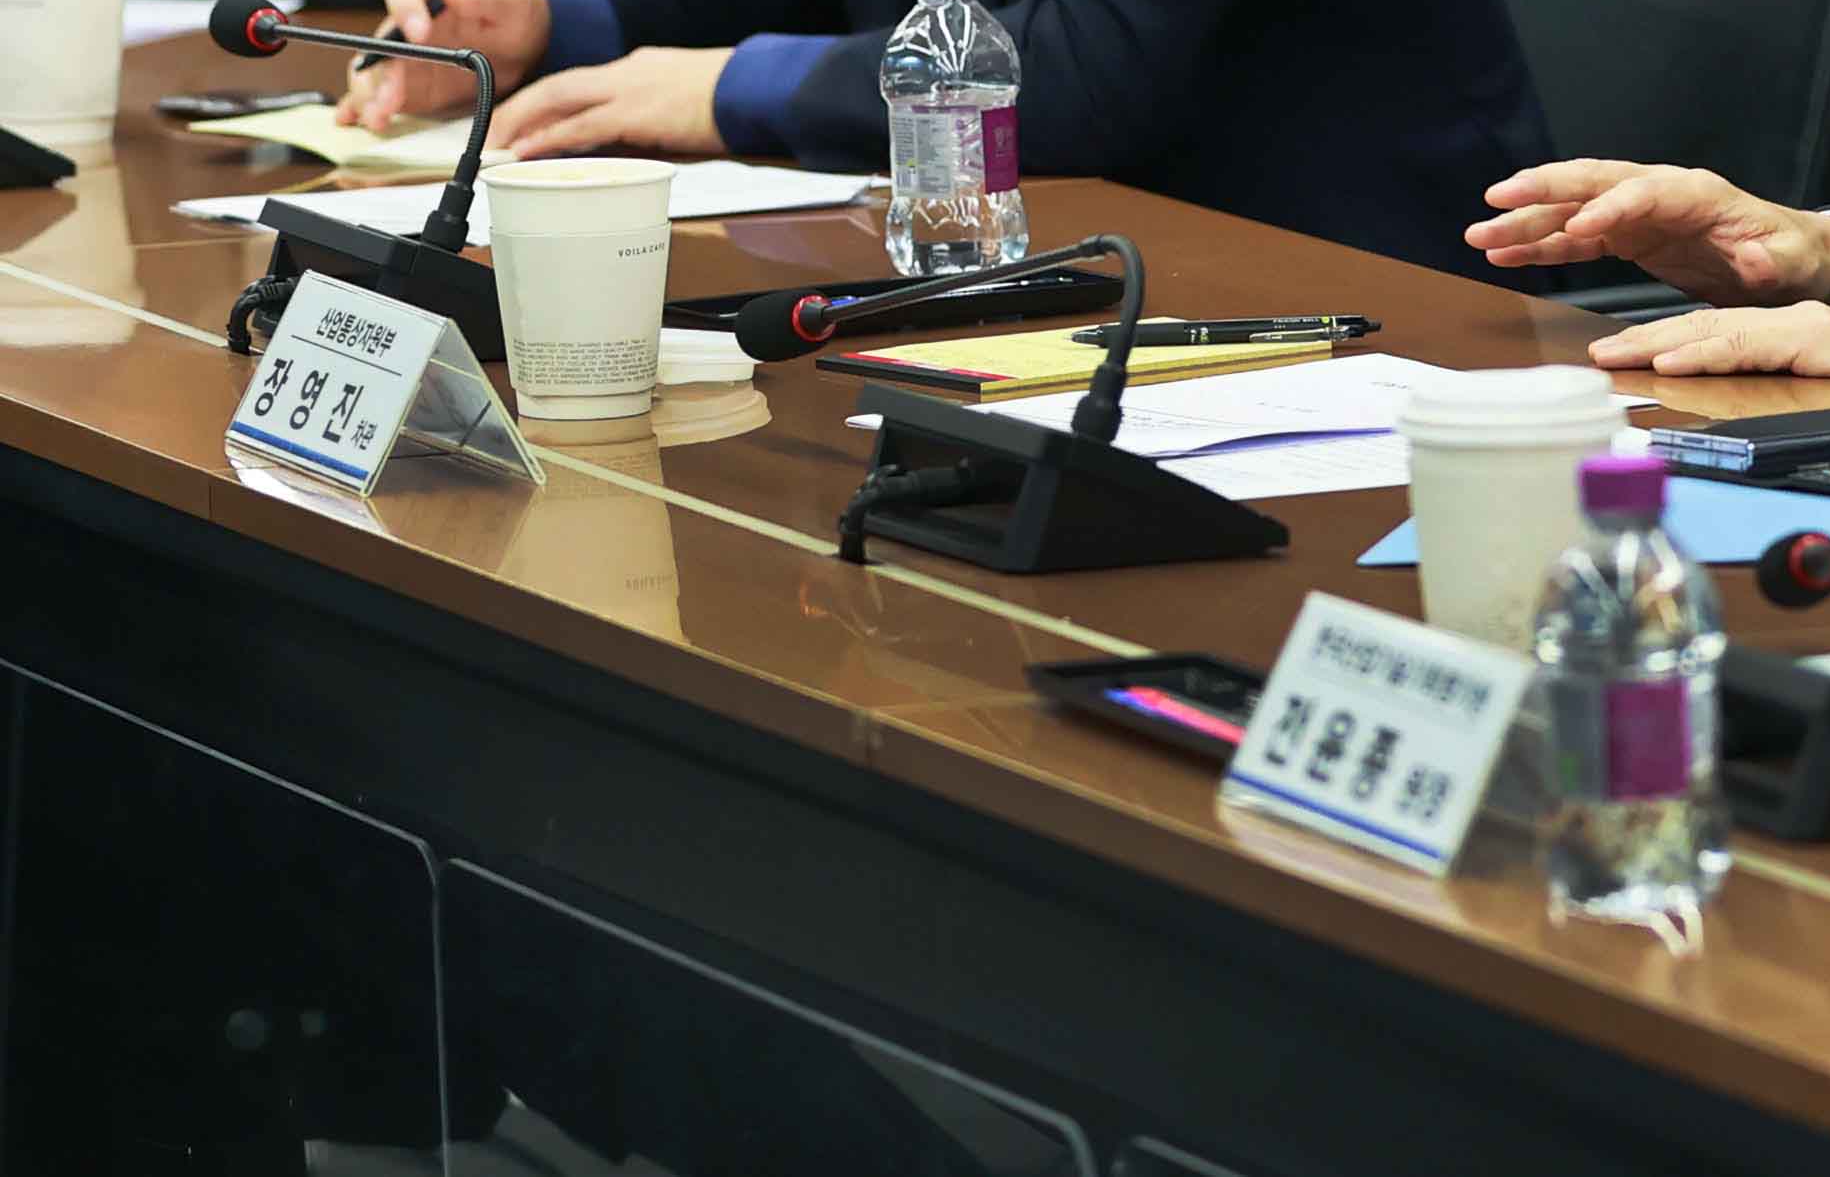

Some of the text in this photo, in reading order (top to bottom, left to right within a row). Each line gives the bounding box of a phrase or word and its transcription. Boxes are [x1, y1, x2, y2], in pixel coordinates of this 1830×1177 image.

[619, 246, 647, 258] VOILA
[316, 308, 397, 357] 산업통상자원부
[351, 420, 377, 450] 차관
